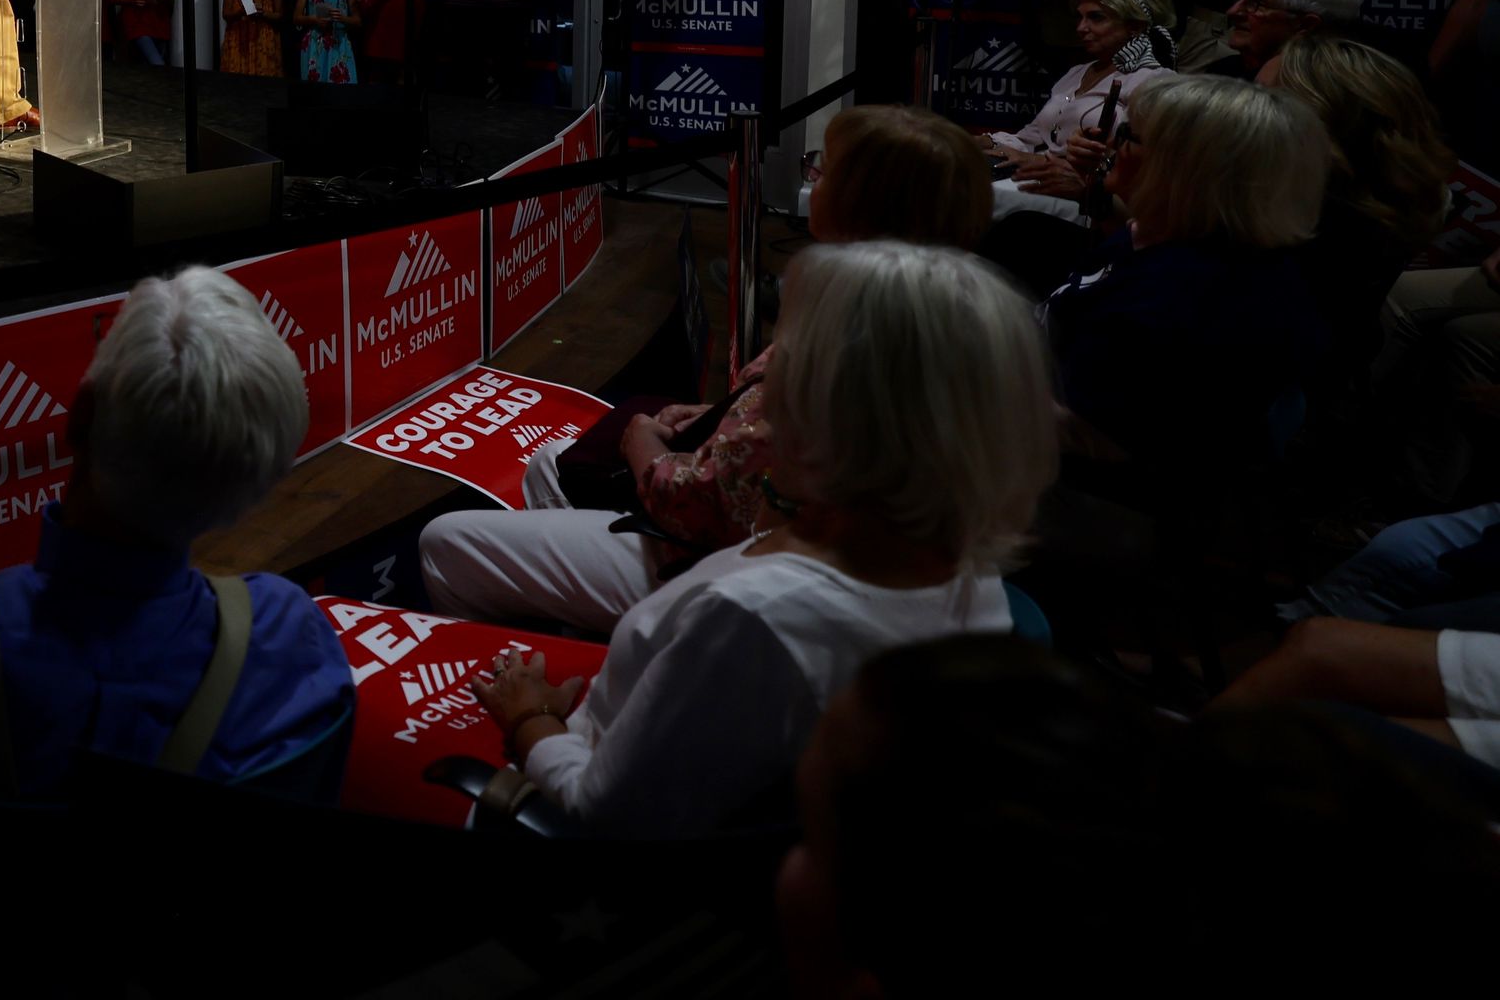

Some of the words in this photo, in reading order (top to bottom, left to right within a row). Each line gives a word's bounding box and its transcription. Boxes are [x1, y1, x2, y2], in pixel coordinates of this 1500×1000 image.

[652, 18, 676, 30] U.S.
[681, 18, 733, 32] SENATE
[649, 115, 674, 127] U.S.
[678, 116, 725, 131] SENAT
[495, 217, 558, 288] McMULLIN
[507, 278, 521, 302] U.S.
[522, 255, 547, 291] SENATE
[357, 269, 476, 353] McMULLIN
[380, 342, 406, 369] U.S.
[409, 315, 455, 352] SENATE
[376, 371, 514, 454] COURAGE
[419, 431, 475, 461] TO
[461, 387, 543, 436] LEAD
[349, 612, 458, 687] LEA
[447, 713, 486, 731] U.S.
